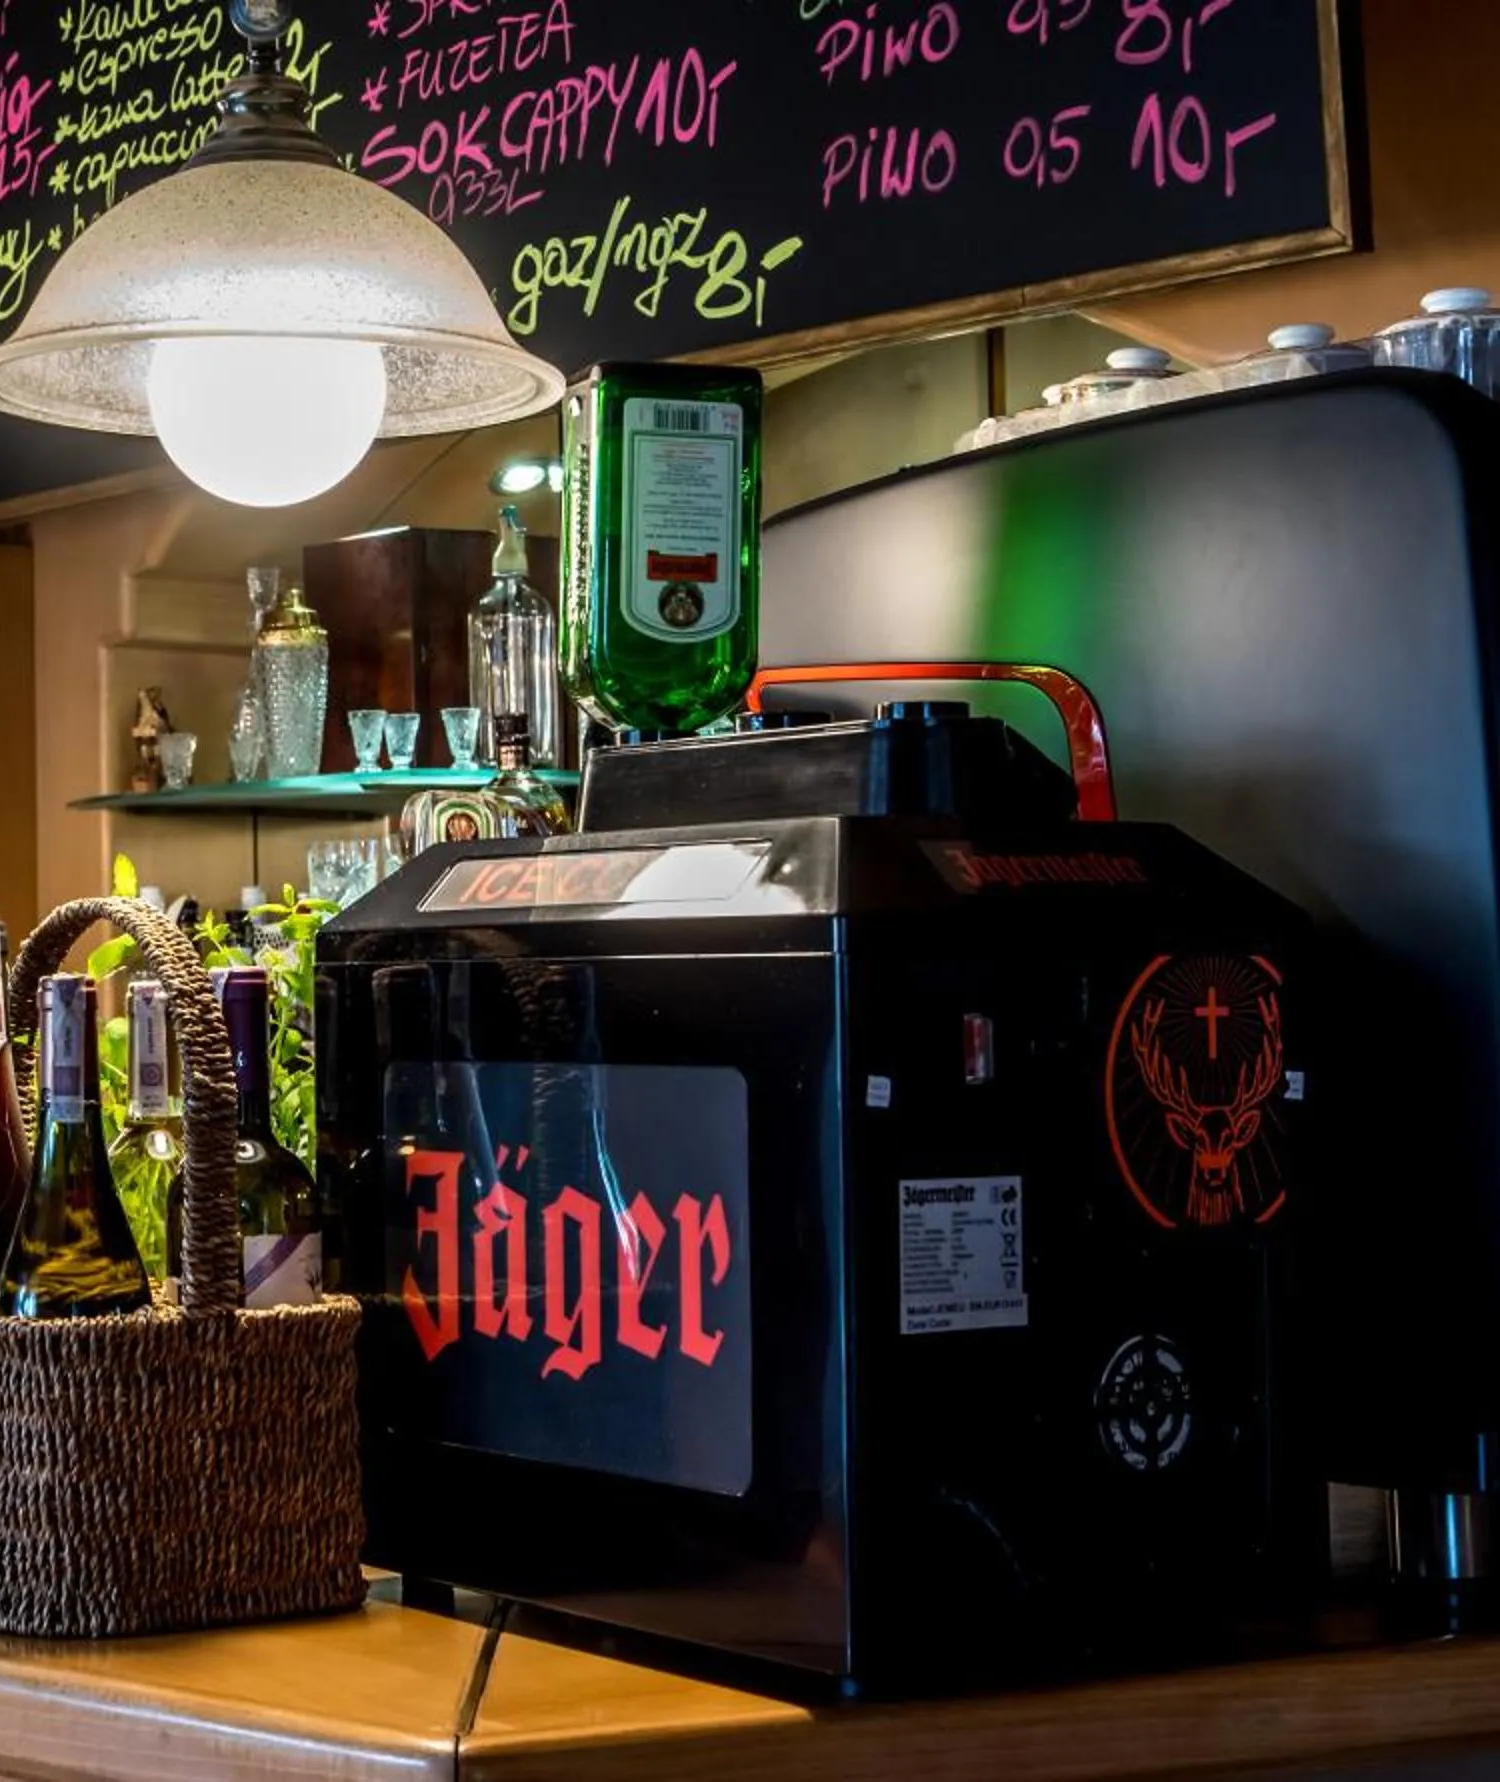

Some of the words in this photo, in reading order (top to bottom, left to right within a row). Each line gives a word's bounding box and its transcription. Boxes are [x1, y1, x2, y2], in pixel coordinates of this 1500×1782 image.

[361, 105, 495, 187] SOK
[501, 54, 641, 174] CAPPY
[403, 1145, 732, 1381] Jäger
